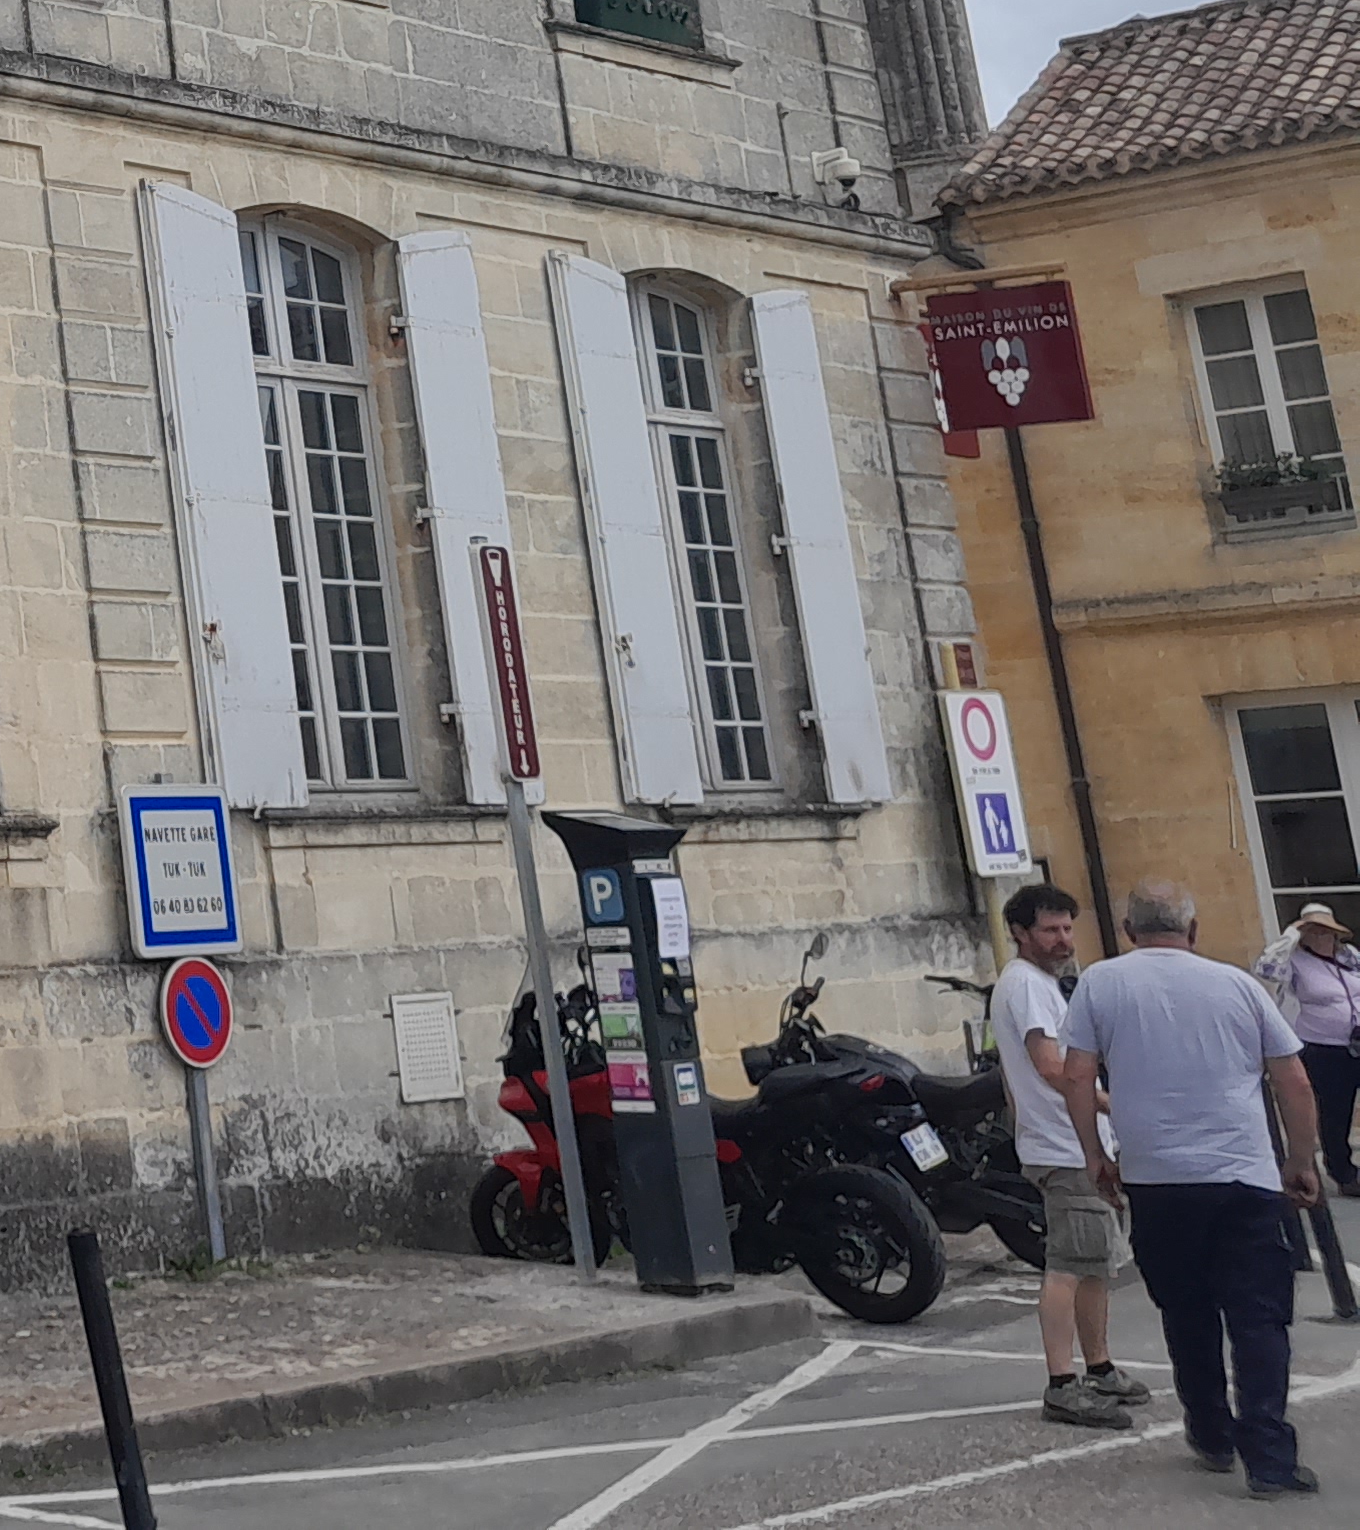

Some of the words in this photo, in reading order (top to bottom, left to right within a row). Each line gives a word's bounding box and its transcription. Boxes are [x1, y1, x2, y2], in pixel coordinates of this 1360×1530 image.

[992, 307, 1012, 320] DU
[934, 314, 1069, 341] SAINT-EMILION
[144, 827, 187, 843] NAVETTE
[190, 826, 216, 842] GARE
[589, 874, 613, 915] P
